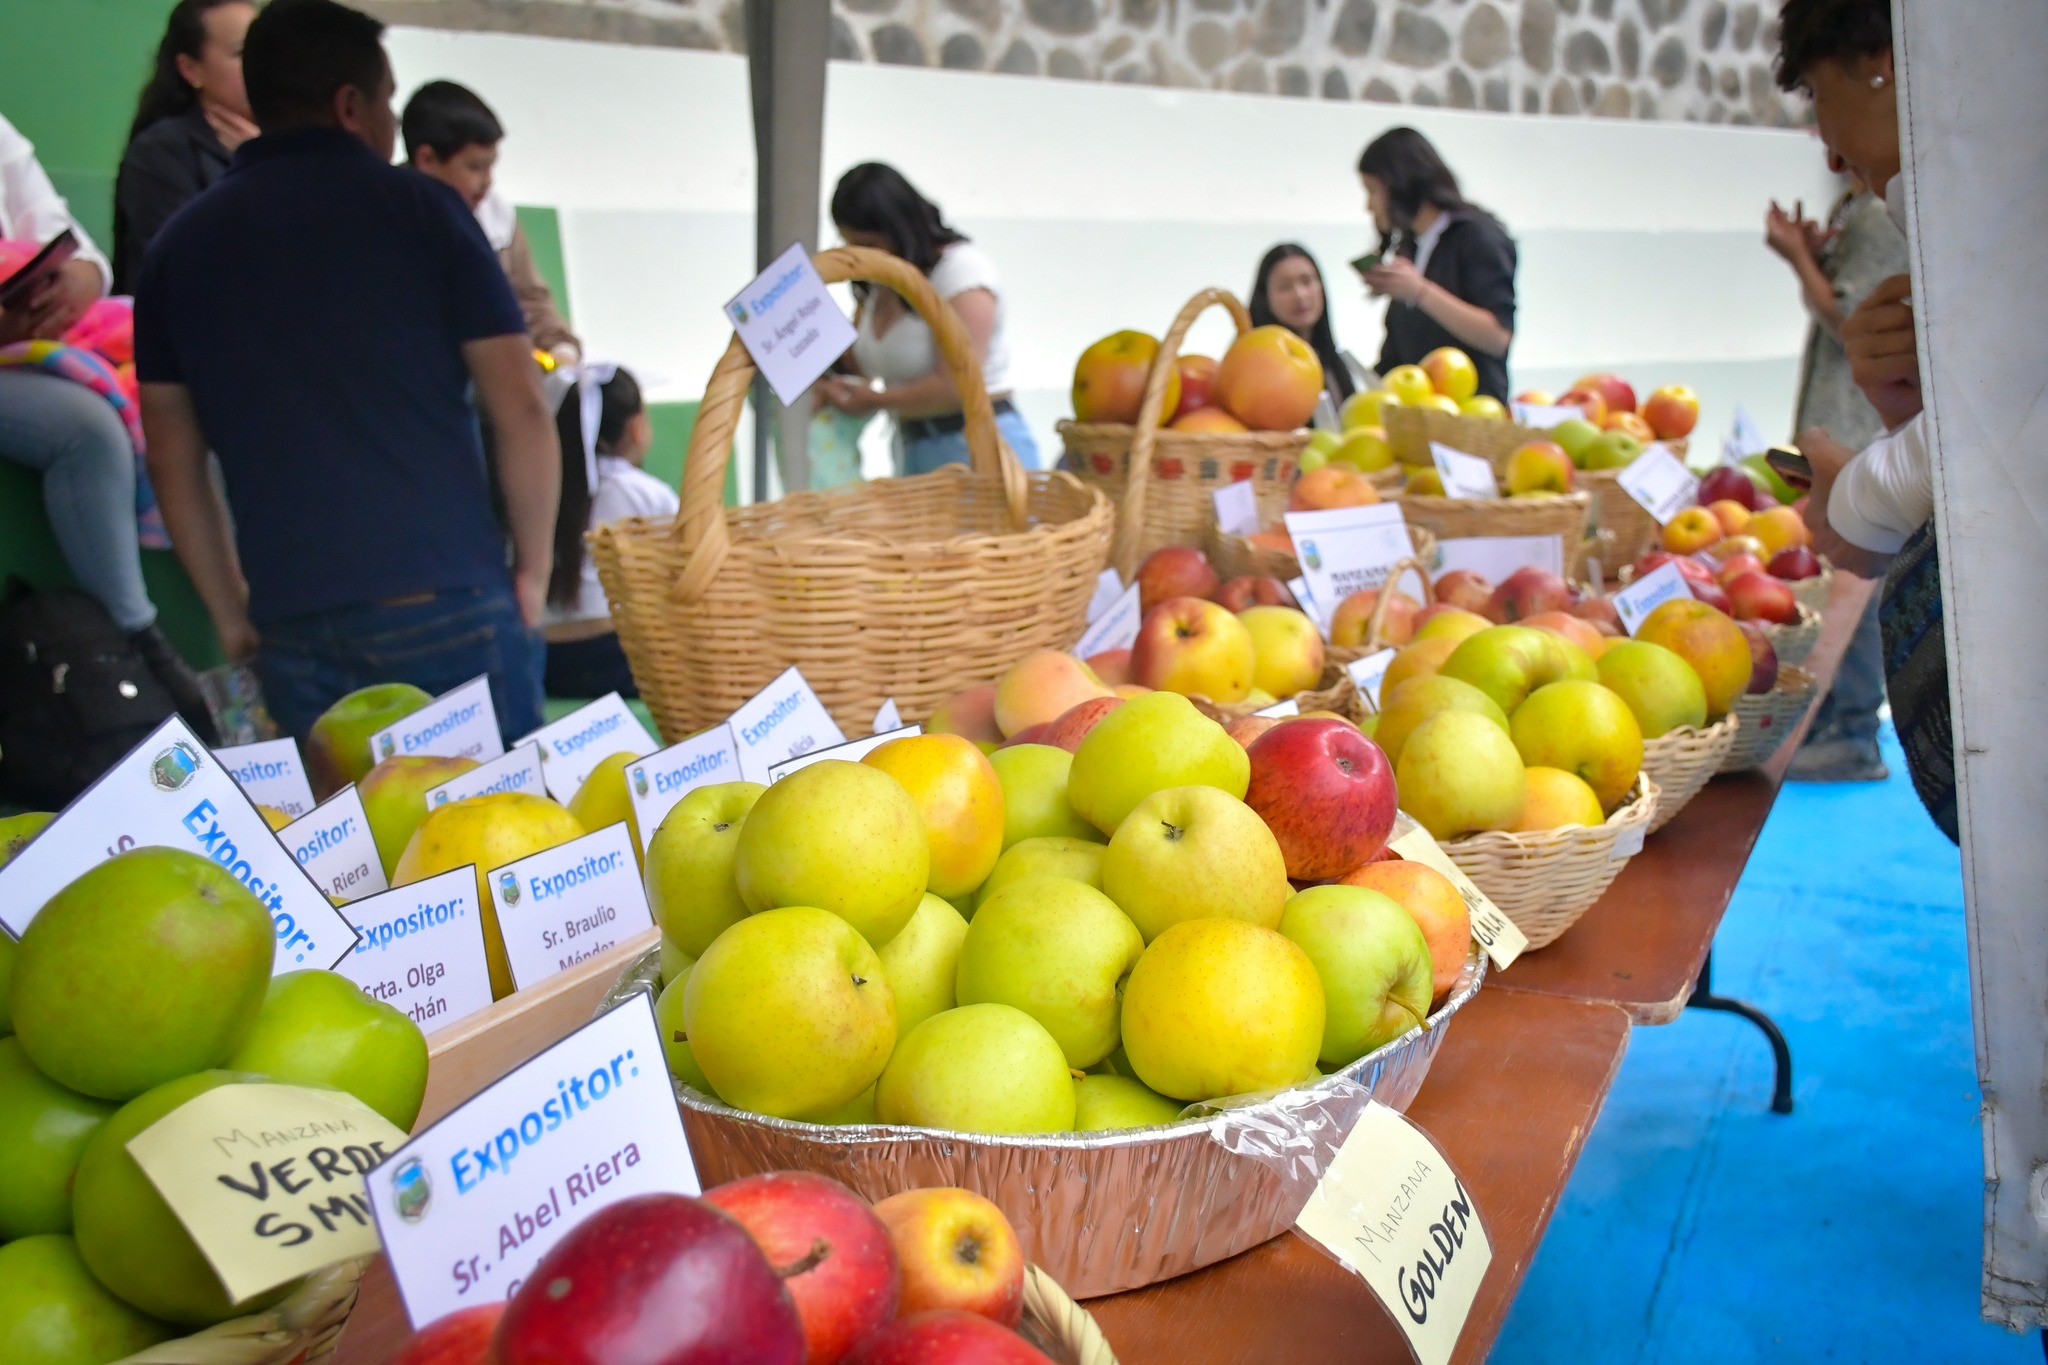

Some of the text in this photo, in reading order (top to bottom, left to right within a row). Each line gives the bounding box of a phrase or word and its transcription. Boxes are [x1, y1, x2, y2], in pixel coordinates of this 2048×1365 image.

[403, 701, 483, 752] Expositor:
[553, 713, 627, 757] Expositor:
[740, 689, 806, 748] Expositor:
[230, 760, 291, 784] ositor:
[654, 748, 730, 795] Expositor:
[296, 817, 357, 865] ositor:
[181, 798, 316, 963] Expositor:
[332, 862, 370, 896] Riera
[529, 850, 624, 902] Expositor:
[354, 898, 466, 954] Expositor:
[542, 906, 616, 949] Sr. Braulio
[1472, 911, 1506, 947] GALA
[407, 962, 445, 987] Olga
[213, 1119, 358, 1159] MANZANA
[450, 1049, 640, 1196] Expositor:
[452, 1255, 491, 1295] Sr.
[499, 1187, 561, 1261] Abel
[566, 1142, 641, 1206] Riera
[1355, 1160, 1431, 1263] MANZANA
[1398, 1177, 1470, 1325] GOLDEN
